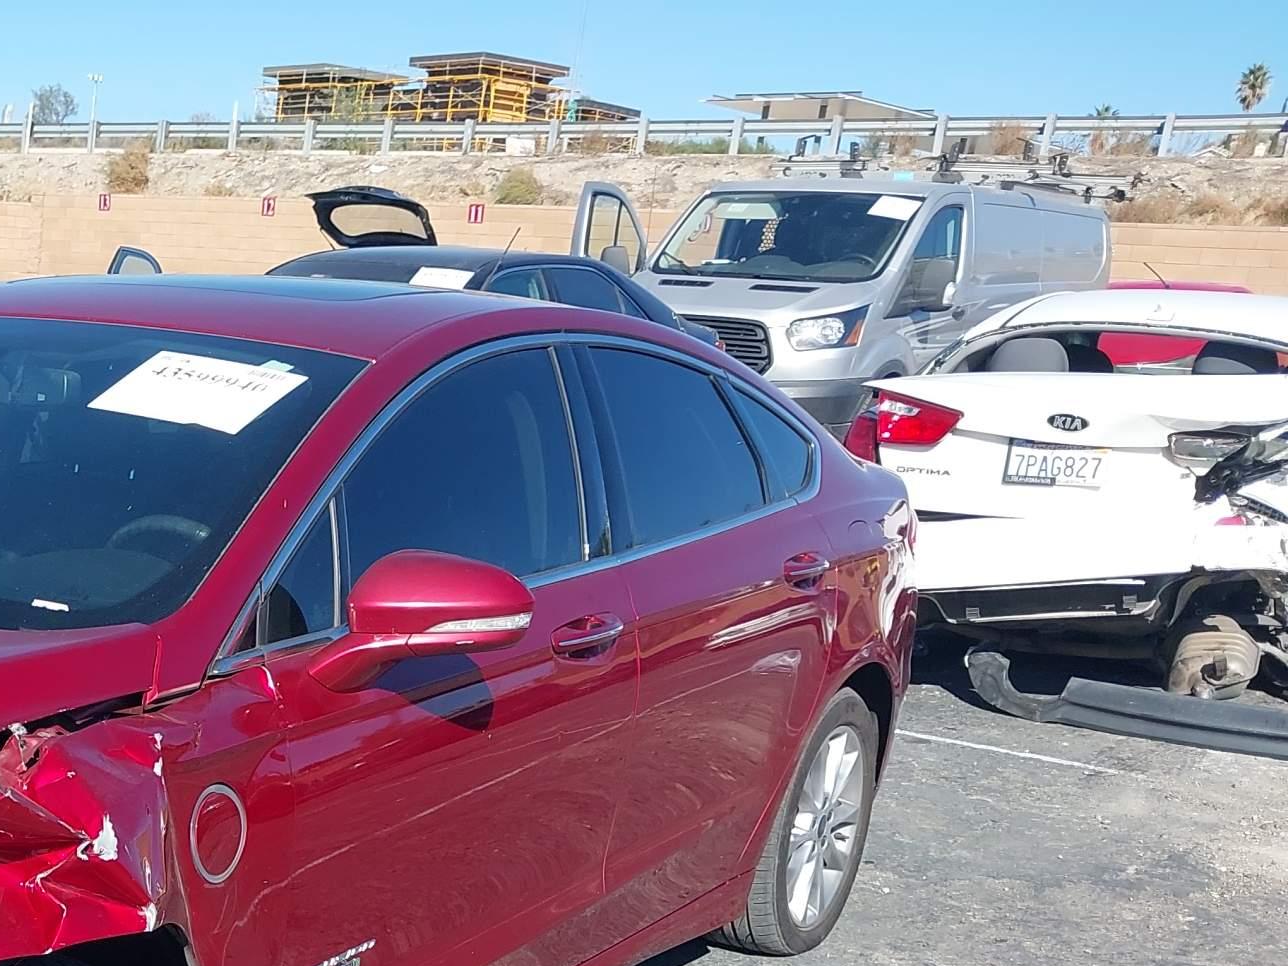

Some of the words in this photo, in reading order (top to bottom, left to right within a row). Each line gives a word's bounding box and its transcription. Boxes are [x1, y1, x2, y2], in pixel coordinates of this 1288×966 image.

[100, 194, 110, 210] 13
[263, 198, 275, 216] 12
[470, 204, 483, 223] 11
[1053, 415, 1083, 431] KIA
[896, 465, 951, 476] OPTIMA
[1014, 453, 1103, 480] 7PAG827
